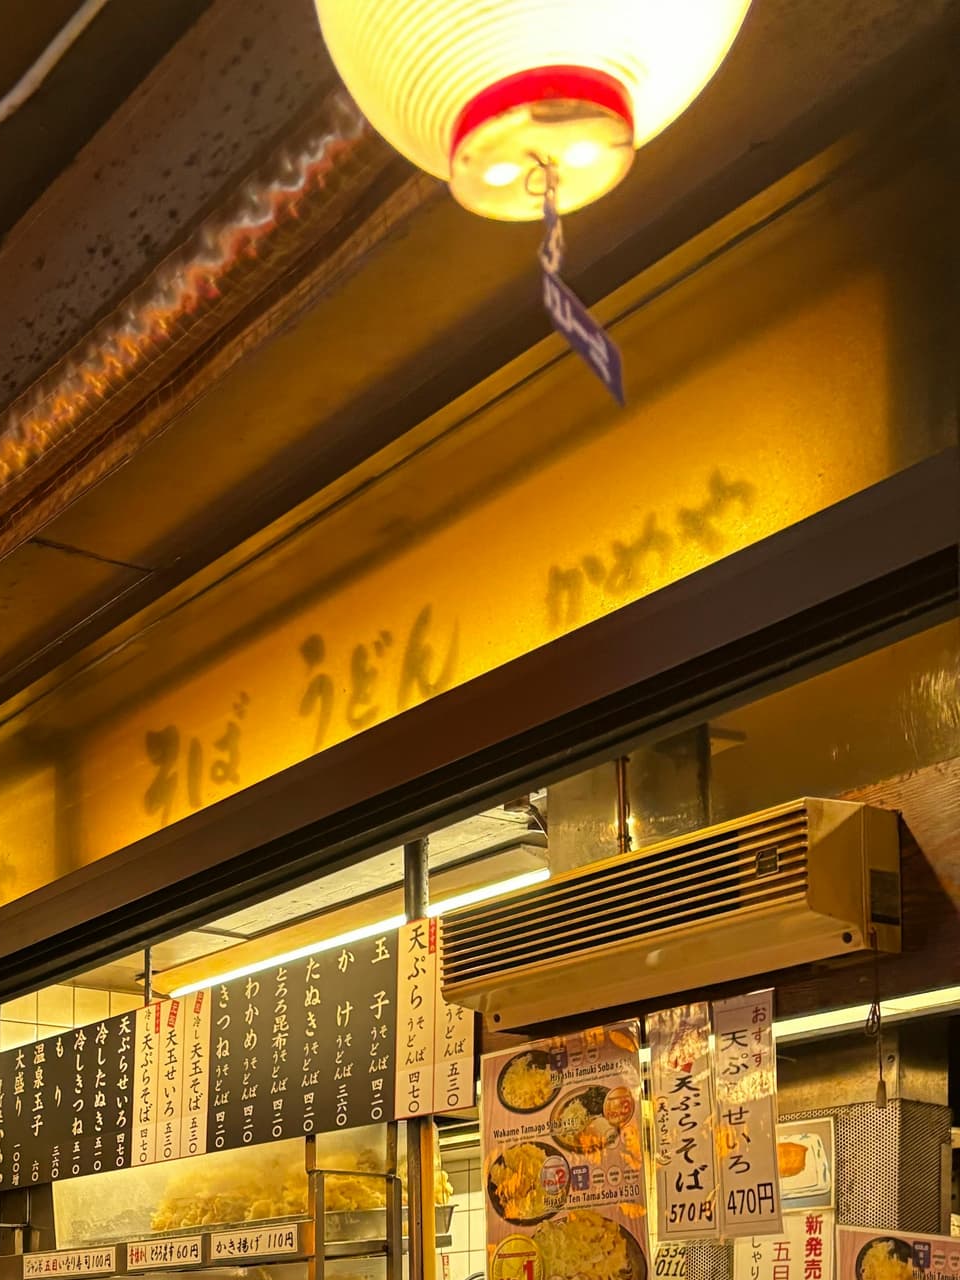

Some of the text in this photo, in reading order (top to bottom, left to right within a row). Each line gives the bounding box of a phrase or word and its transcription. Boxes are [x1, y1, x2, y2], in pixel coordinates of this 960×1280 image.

[298, 603, 460, 752] うどん
[143, 689, 251, 825] そば
[335, 949, 355, 1028] かけ
[370, 937, 391, 1020] 玉子
[407, 927, 428, 1010] 天ぷら
[243, 978, 260, 1050] わかめ
[272, 967, 290, 1050] とろろ昆布
[304, 958, 321, 1037] たぬき
[215, 985, 231, 1058] きつね
[13, 1050, 26, 1117] 大盛り
[163, 1030, 180, 1117] 天玉せいろ
[446, 1062, 460, 1107] 五三〇
[598, 1063, 614, 1074] Soba
[30, 1044, 46, 1137] 温泉玉子
[72, 1030, 88, 1175] 冷しきつね 五一〇
[93, 1023, 109, 1171] 冷したぬき 五一〇
[115, 1015, 132, 1167] 天ぷらせいろ 四七〇
[303, 1092, 314, 1132] 四二〇
[335, 1084, 348, 1126] 三六〇
[371, 1078, 384, 1120] 四二〇
[408, 1071, 420, 1113] 四七〇
[188, 1117, 198, 1154] 五三〇
[215, 1111, 225, 1147] 四二〇
[242, 1105, 253, 1143] 四二〇
[272, 1099, 283, 1137] 四二〇
[493, 1127, 520, 1139] Wakame
[668, 1074, 709, 1193] 天ぷらそば
[51, 1145, 61, 1178] 三六〇
[139, 1129, 149, 1163] 四七〇
[163, 1122, 173, 1158] 五三〇
[618, 1184, 640, 1198] ¥530
[669, 1200, 713, 1223] 570円
[727, 1182, 775, 1216] 470円
[176, 1242, 199, 1260] 60円
[215, 1230, 295, 1255] かき揚げ 110円
[804, 1213, 824, 1280] 新発売
